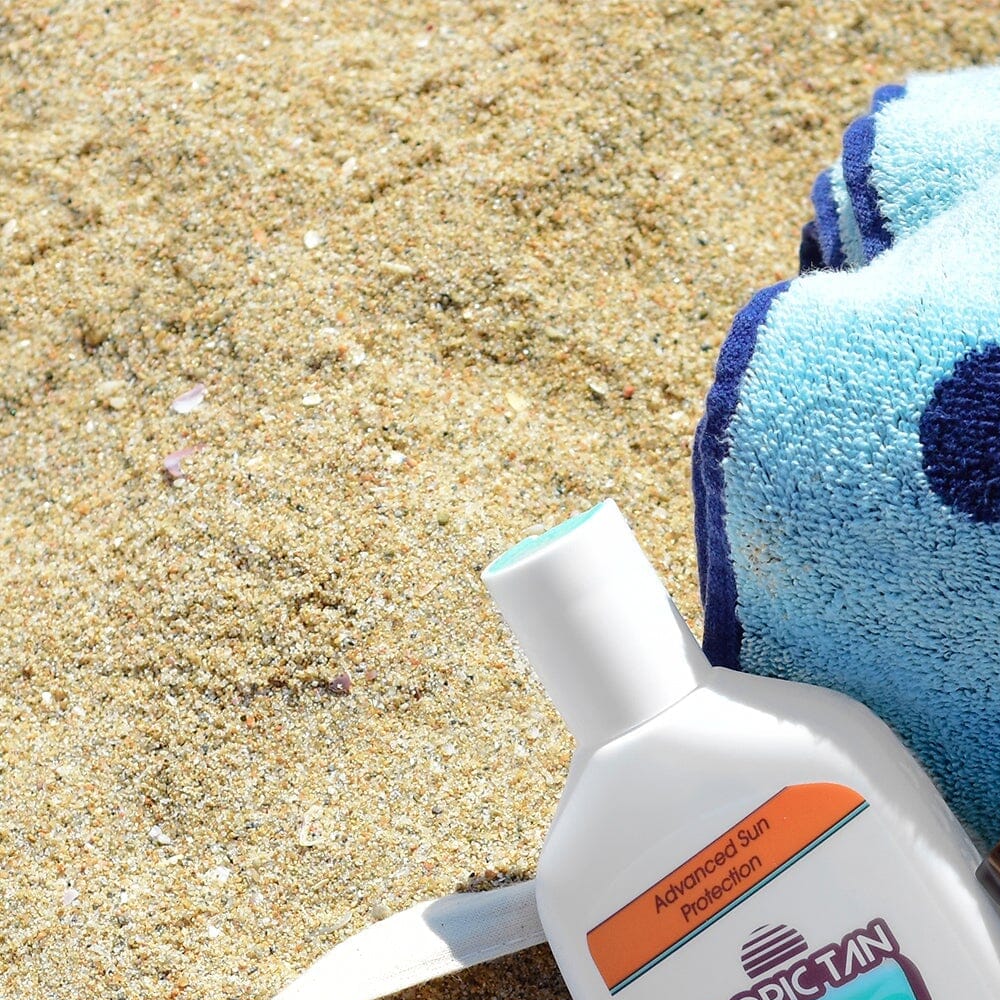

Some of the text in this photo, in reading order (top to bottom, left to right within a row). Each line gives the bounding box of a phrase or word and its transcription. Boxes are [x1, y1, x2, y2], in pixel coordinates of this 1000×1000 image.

[653, 816, 770, 913] Advanced Sun
[679, 853, 763, 923] Protection
[814, 923, 894, 982] TAN
